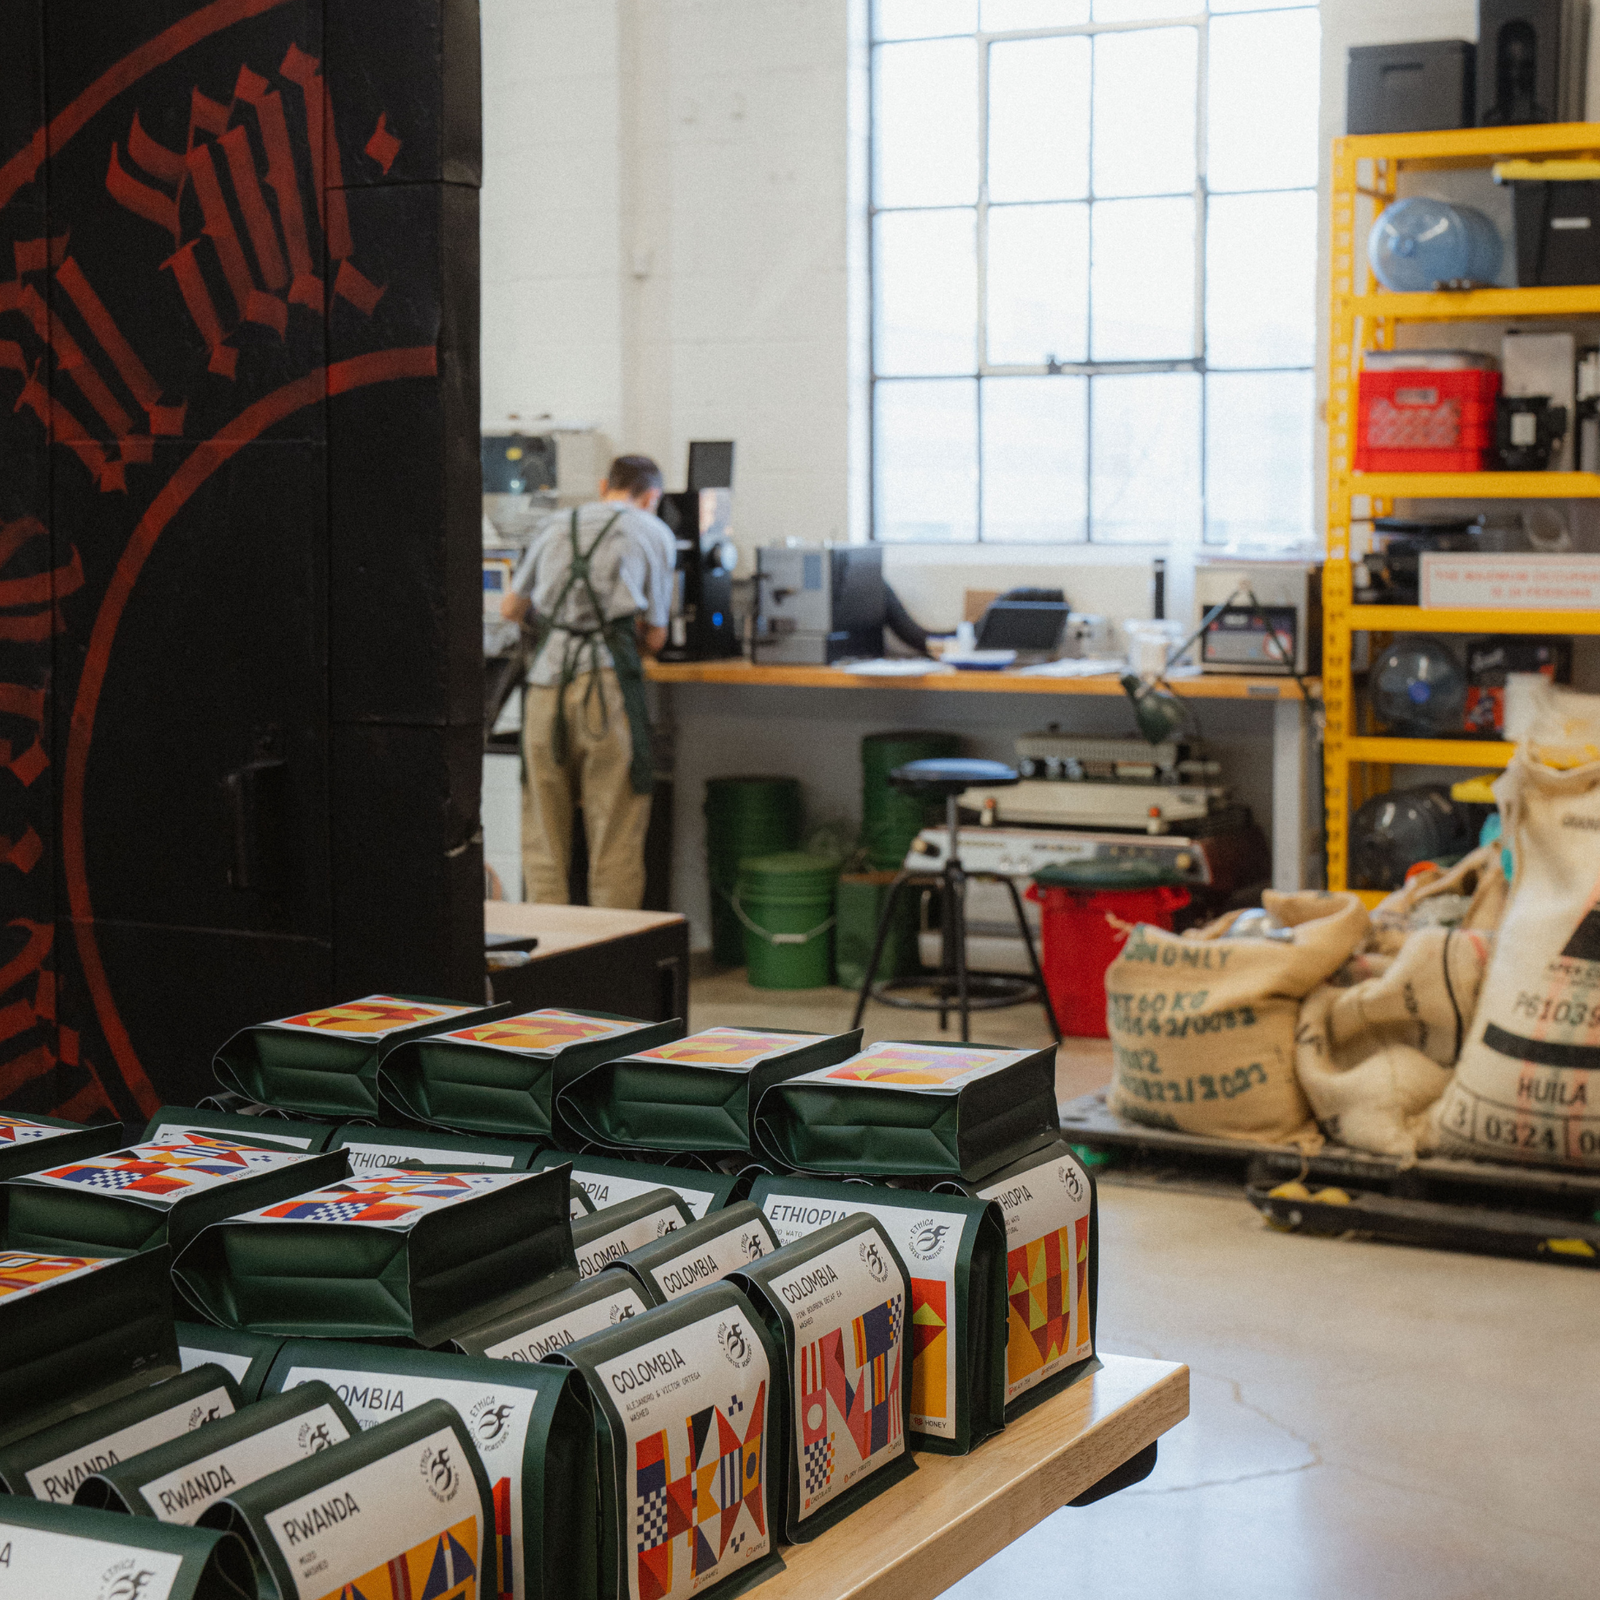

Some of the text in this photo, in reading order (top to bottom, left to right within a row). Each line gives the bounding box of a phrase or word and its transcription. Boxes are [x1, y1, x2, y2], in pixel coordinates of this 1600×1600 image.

[1518, 1078, 1588, 1105] HUILA
[910, 1218, 934, 1234] ETHICA
[663, 1254, 719, 1294] COLOMBIA
[781, 1264, 839, 1304] COLOMBIA
[612, 1348, 687, 1395] COLOMBIA
[626, 1393, 656, 1412] ALEJANDRO
[661, 1381, 681, 1396] VICTOR
[681, 1371, 702, 1388] ORTEGA
[630, 1407, 650, 1423] WASHED
[925, 1419, 947, 1429] HONEY
[158, 1465, 236, 1516] RWANDA
[283, 1492, 361, 1546] RWANDA
